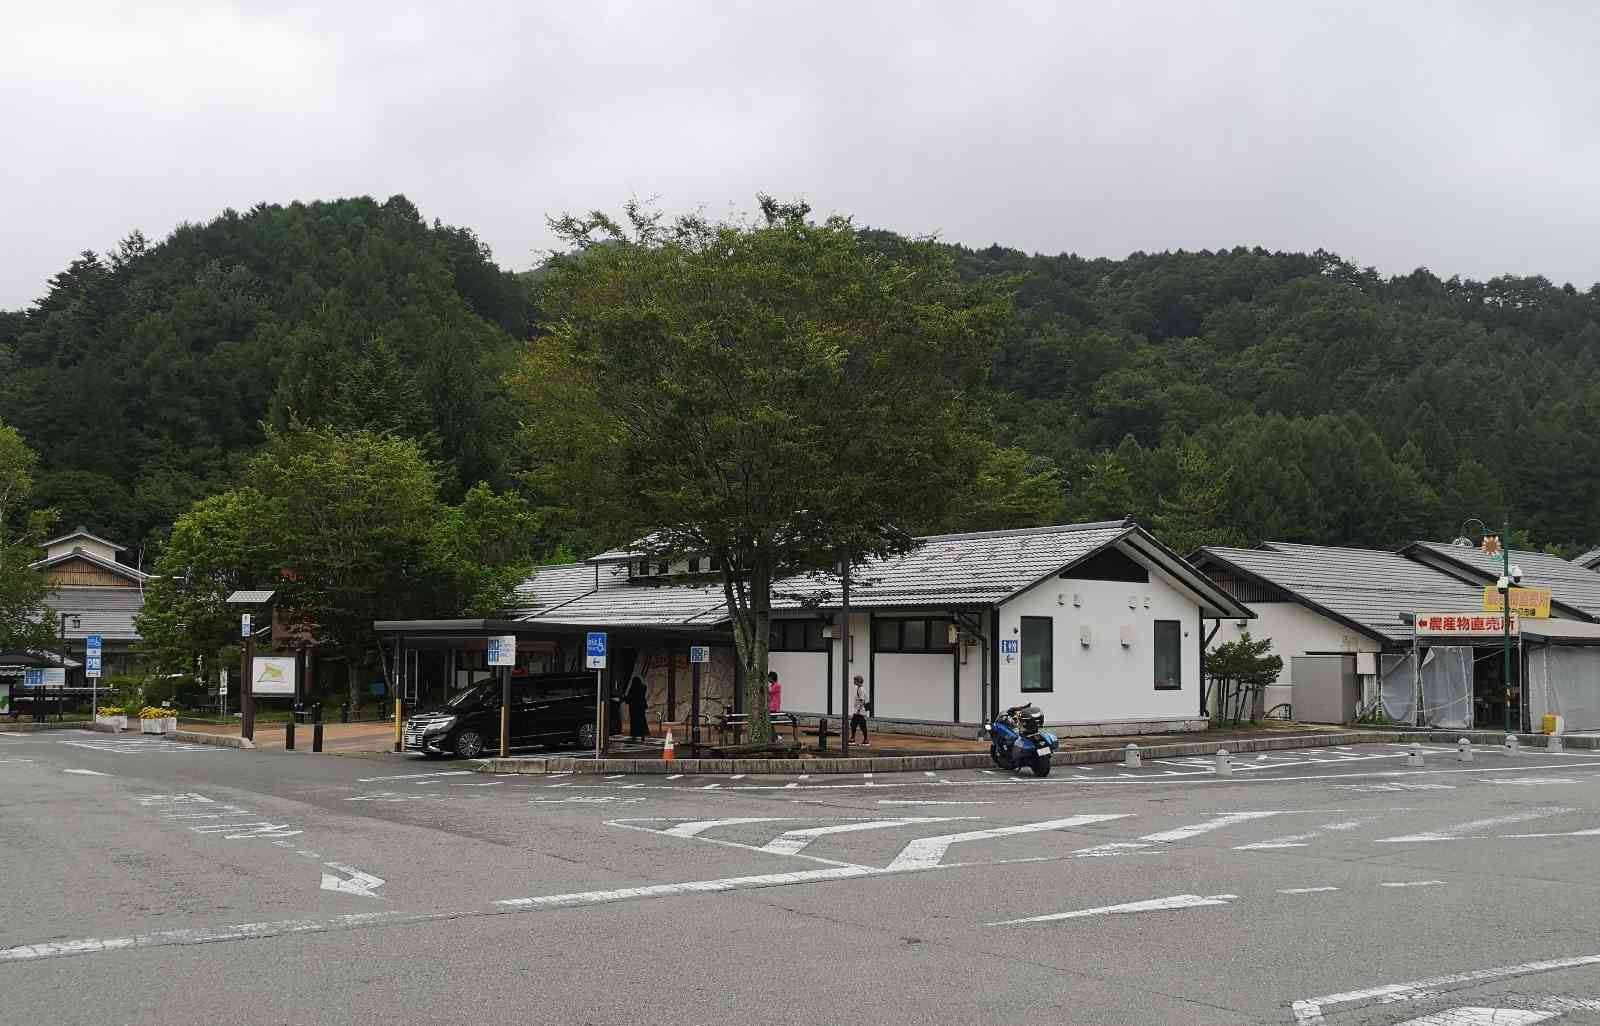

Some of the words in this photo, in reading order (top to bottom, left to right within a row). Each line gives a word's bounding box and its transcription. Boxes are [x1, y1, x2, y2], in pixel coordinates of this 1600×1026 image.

[1429, 616, 1515, 631] 農産物直売所
